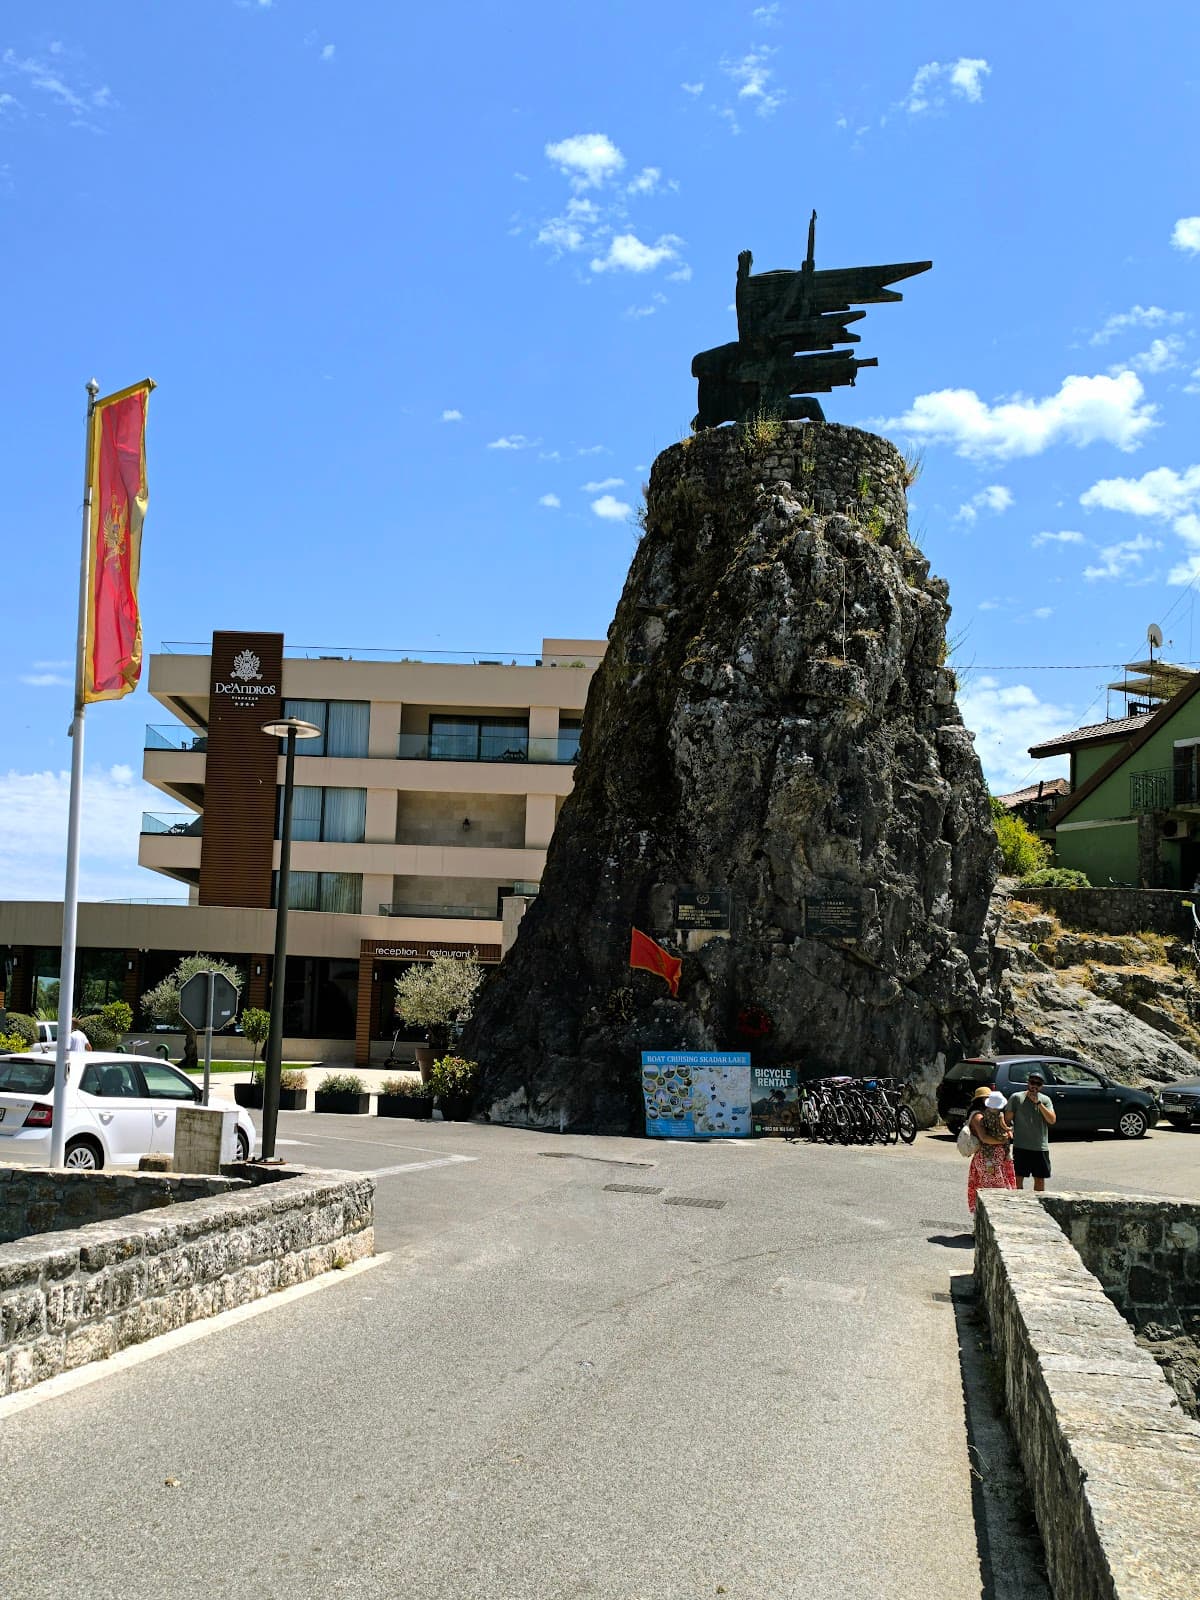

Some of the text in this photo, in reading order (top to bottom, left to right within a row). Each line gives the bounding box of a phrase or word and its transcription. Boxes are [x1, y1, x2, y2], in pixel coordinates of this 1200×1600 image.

[375, 947, 471, 959] reception restaurant
[647, 1055, 746, 1064] BOAT CRUISING SKADAR LAKE
[754, 1068, 792, 1079] BICYCLE
